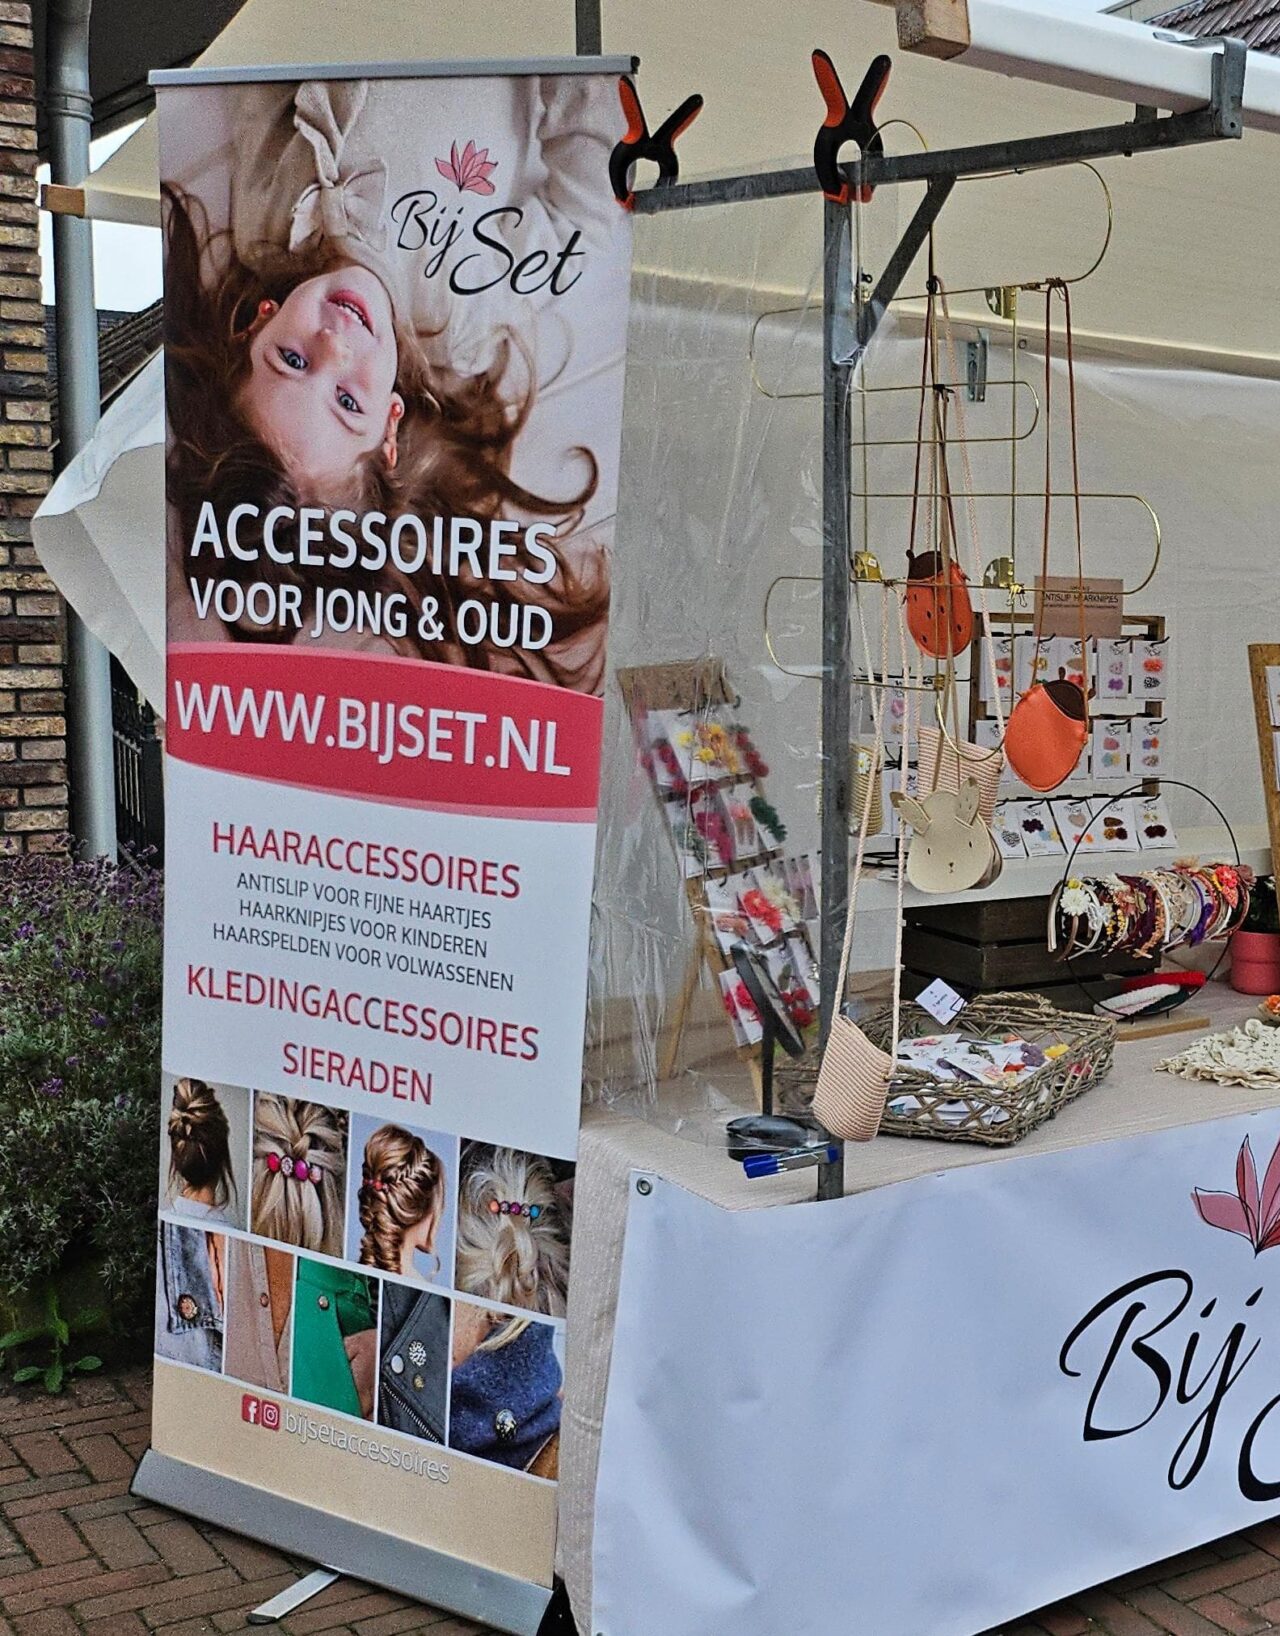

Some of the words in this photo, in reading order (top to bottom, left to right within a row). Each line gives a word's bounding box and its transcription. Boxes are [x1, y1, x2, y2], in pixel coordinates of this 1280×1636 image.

[391, 190, 465, 279] Bij
[449, 207, 586, 296] Set
[190, 501, 557, 585] ACCESSOIRES
[190, 576, 303, 629] VOOR
[311, 585, 407, 639] JONG
[418, 596, 444, 641] &
[456, 600, 553, 650] OUD
[174, 680, 571, 777] WWW.BIJSET.NL
[212, 821, 521, 899] HAARACCESSOIRES
[236, 872, 309, 899] ANTISLIP
[313, 883, 360, 907] VOOR
[364, 891, 404, 916] FIJNE
[409, 899, 492, 930] HAARTJES
[239, 899, 345, 933] HAARKNIPJES
[350, 917, 397, 943] VOOR
[401, 923, 487, 959] KINDEREN
[213, 922, 330, 958] HAARSPELDEN
[336, 942, 381, 968] VOOR
[386, 951, 514, 993] VOLWASSENEN
[186, 963, 540, 1062] KLEDINGACCESSOIRES
[282, 1041, 433, 1106] SIERADEN
[1058, 1268, 1264, 1491] Bij
[285, 1407, 451, 1484] bijsetaccessoires
